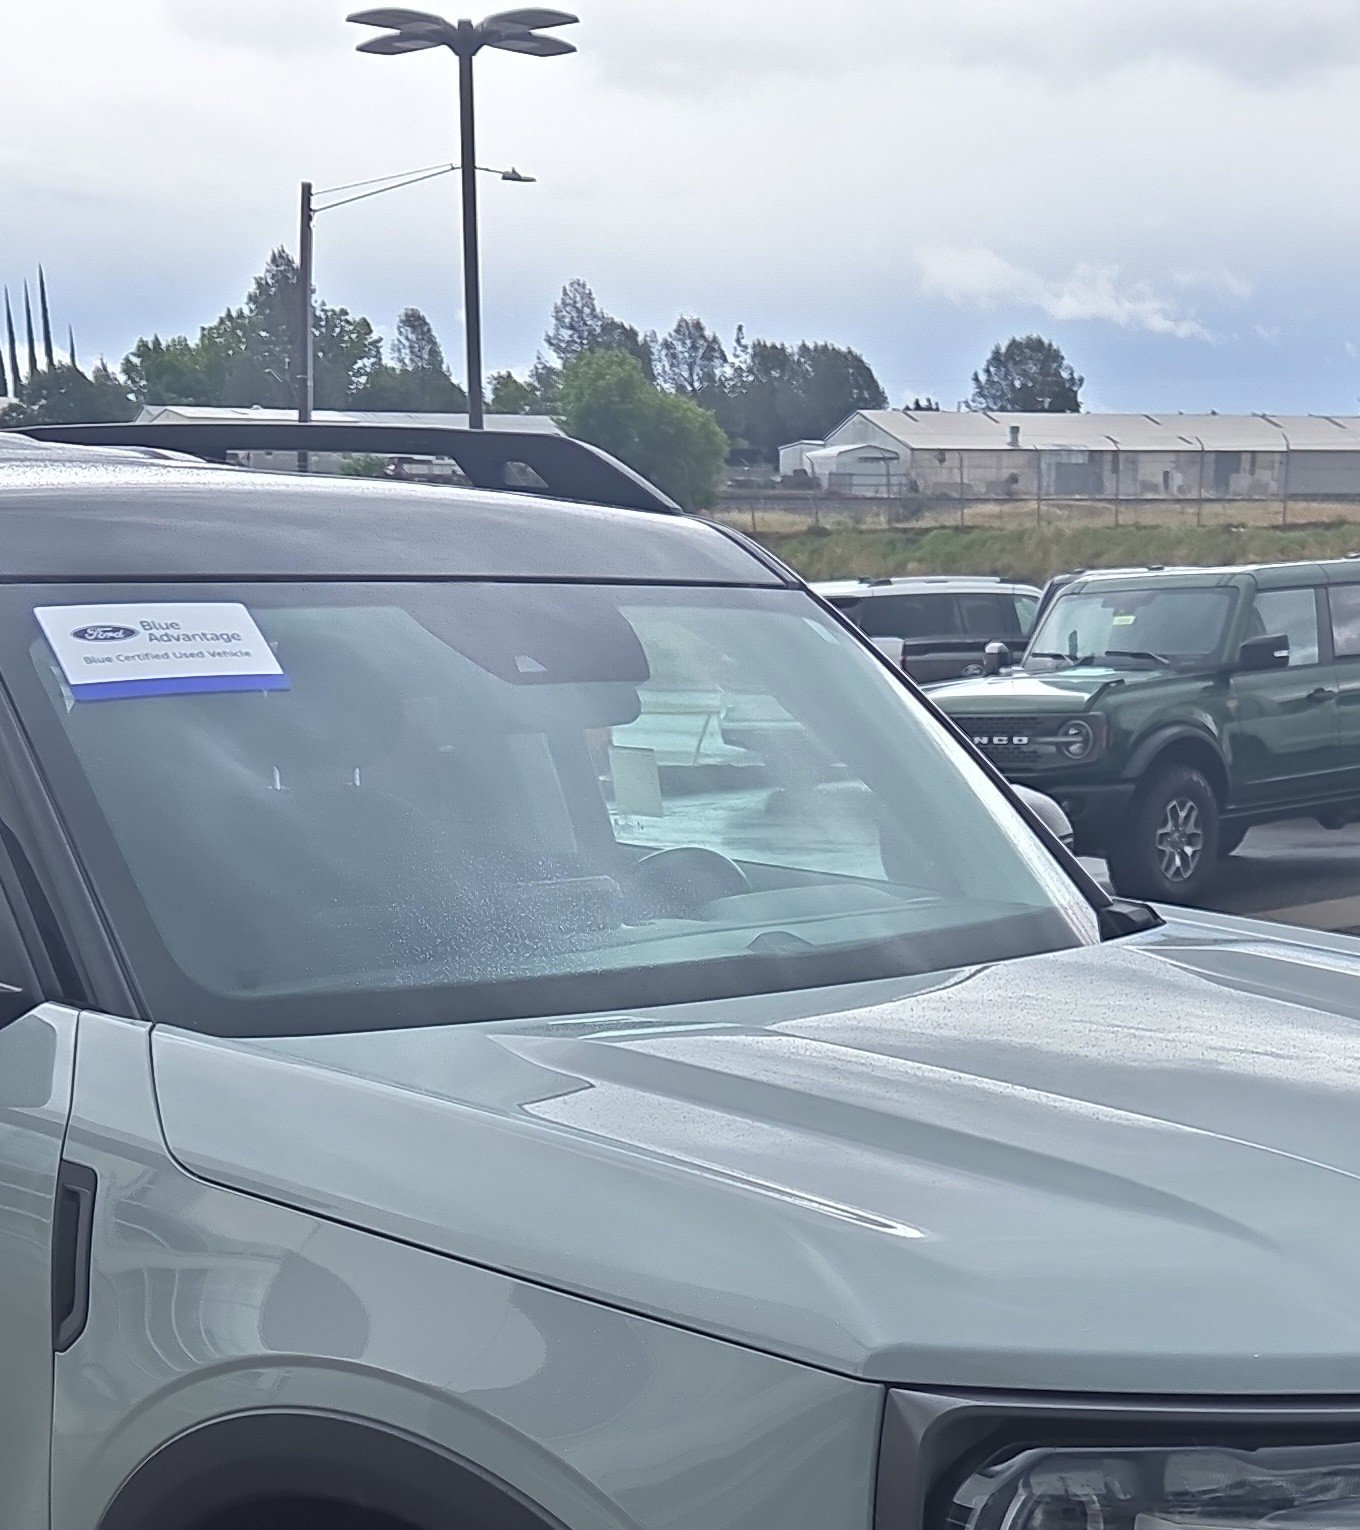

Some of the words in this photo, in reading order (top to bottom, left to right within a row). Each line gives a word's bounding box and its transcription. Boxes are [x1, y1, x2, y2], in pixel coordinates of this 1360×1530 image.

[85, 627, 124, 639] Ford
[140, 620, 181, 631] Blue
[148, 630, 242, 643] Advantage
[83, 655, 113, 665] Blue
[117, 650, 170, 662] Certified
[173, 649, 206, 660] Used
[208, 648, 252, 658] Vehicle
